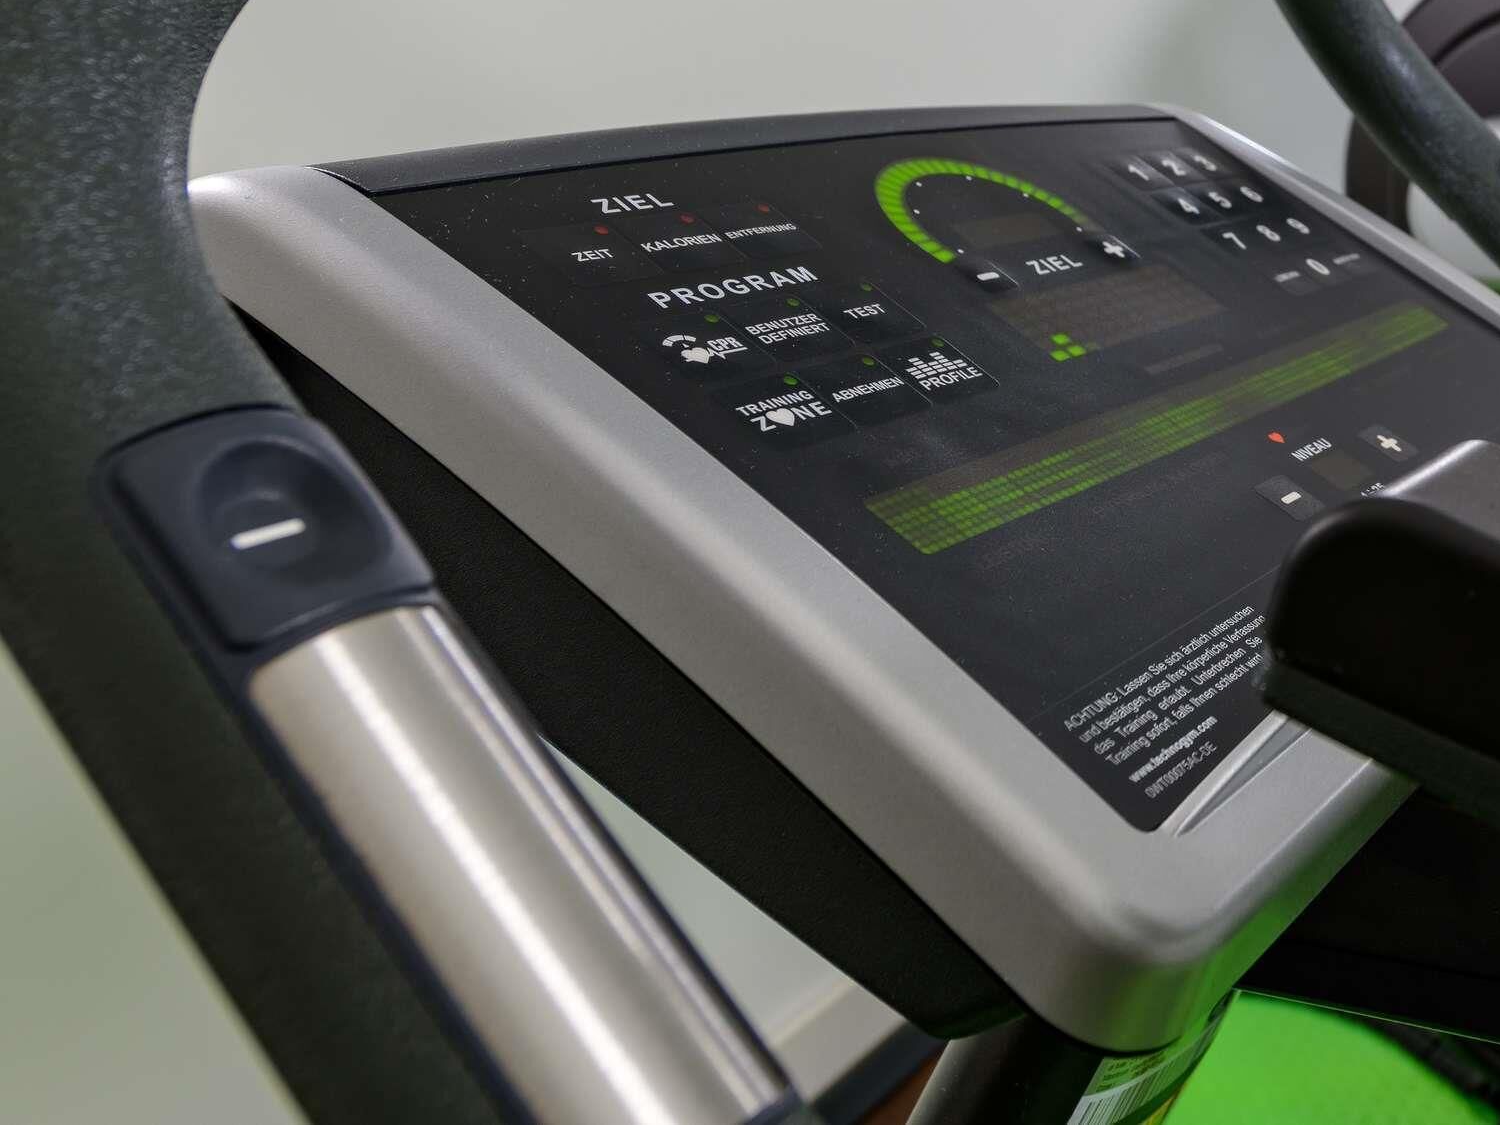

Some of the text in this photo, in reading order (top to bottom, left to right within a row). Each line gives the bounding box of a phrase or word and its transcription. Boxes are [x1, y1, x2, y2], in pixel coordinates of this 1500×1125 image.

[1127, 163, 1150, 182] 1
[1161, 158, 1187, 177] 2
[590, 192, 675, 215] ZIEL
[1177, 197, 1201, 215] 4
[1208, 191, 1233, 209] 5
[640, 232, 723, 253] KALORIEN
[724, 222, 798, 241] ENTFERNUNG
[1221, 231, 1247, 251] 7
[1255, 224, 1281, 242] 8
[570, 247, 615, 263] ZEIT
[1025, 254, 1084, 276] ZIEL
[647, 266, 819, 310] PROGRAM
[843, 303, 887, 319] TEST
[744, 313, 823, 336] BENUTZER
[758, 322, 831, 345] DEFINIERT
[706, 335, 744, 353] CPR
[832, 376, 905, 403] ABNEHMEN
[918, 366, 983, 391] PROFILE
[735, 390, 815, 417] TRAINING
[1290, 437, 1333, 462] NIVEAU
[1116, 672, 1153, 697] Lassen
[1147, 662, 1168, 676] Sie
[1164, 650, 1184, 666] sich
[1208, 606, 1254, 637] untersuchen
[1079, 723, 1102, 743] und
[1147, 679, 1171, 697] dass
[1165, 668, 1188, 684] Ihre
[1182, 640, 1228, 672] körperliche
[1094, 737, 1116, 755] das
[1113, 709, 1159, 737] Training
[1190, 647, 1247, 686] Unterbrechen
[1245, 636, 1263, 649] Sie
[1104, 736, 1151, 765] Training
[1171, 703, 1195, 721] falls
[1188, 687, 1219, 708] Ihnen
[1214, 663, 1250, 691] schlecht
